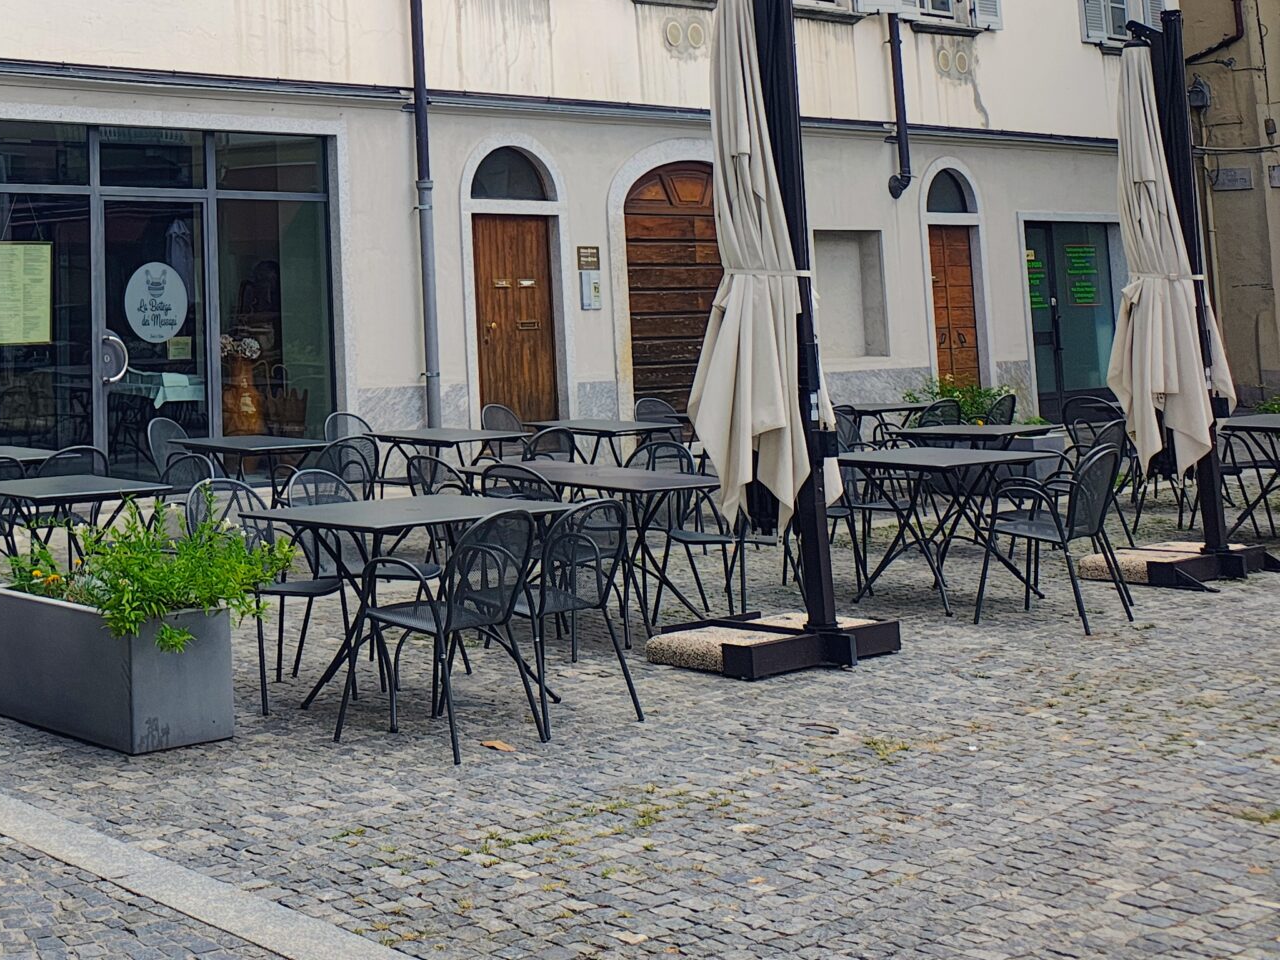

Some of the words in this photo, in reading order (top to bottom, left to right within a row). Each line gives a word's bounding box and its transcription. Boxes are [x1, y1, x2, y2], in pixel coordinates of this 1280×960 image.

[137, 298, 148, 313] La
[149, 298, 173, 316] Bottega
[141, 314, 150, 326] dei
